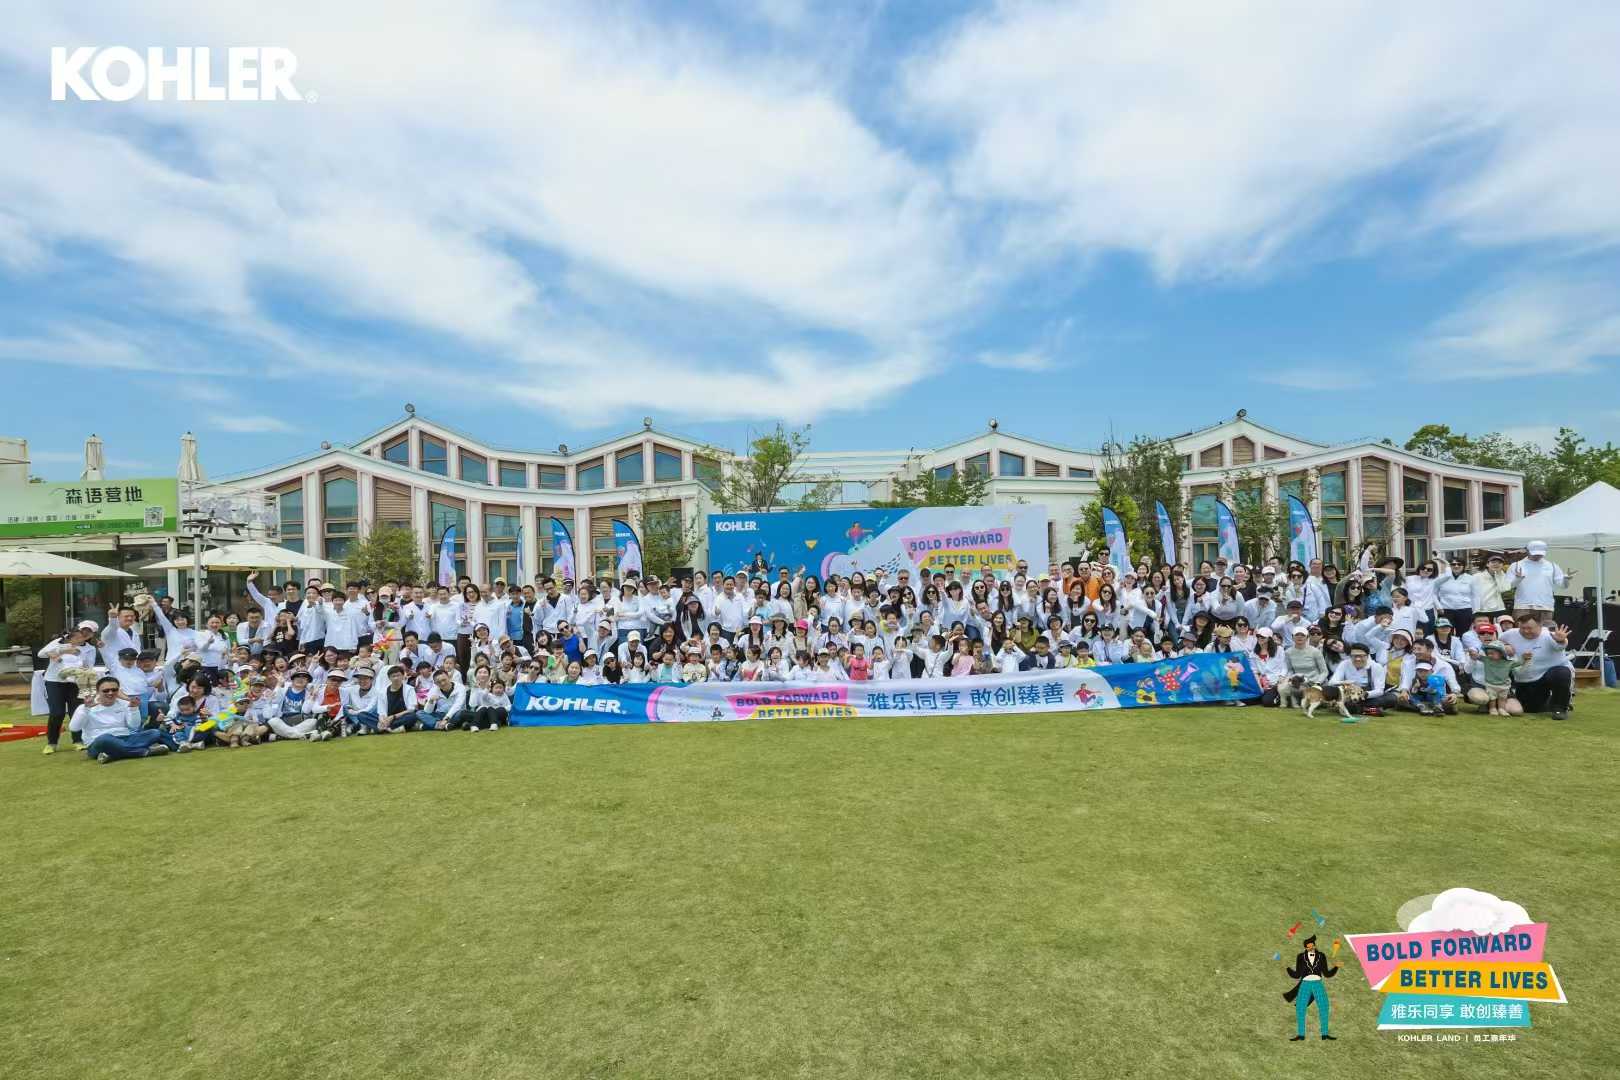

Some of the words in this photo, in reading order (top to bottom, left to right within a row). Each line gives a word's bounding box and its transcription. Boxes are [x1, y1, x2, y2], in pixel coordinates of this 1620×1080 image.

[65, 486, 144, 504] 森语营地
[715, 520, 757, 531] KOHLER
[910, 540, 942, 551] BOLD
[946, 533, 1003, 548] FORWARD
[929, 554, 975, 565] BETTER
[736, 697, 771, 707] BOLD
[775, 691, 839, 704] FORWARD
[867, 690, 961, 710] 雅乐同享
[970, 681, 1064, 707] 敢创臻善
[525, 696, 621, 713] KOHLER
[758, 708, 809, 718] BETTER
